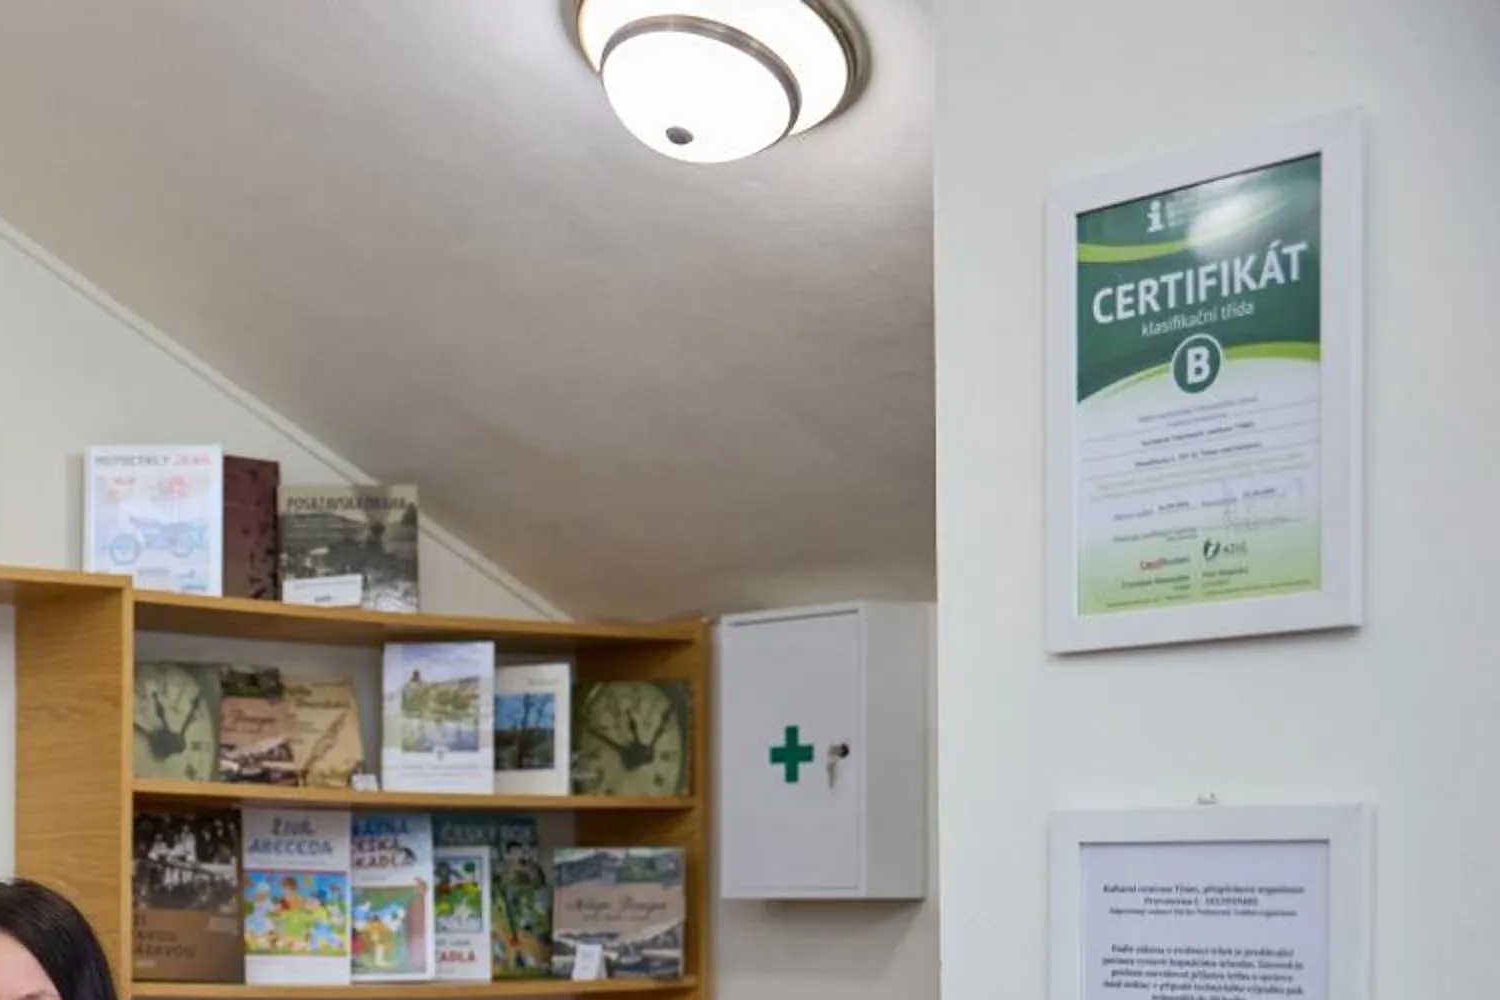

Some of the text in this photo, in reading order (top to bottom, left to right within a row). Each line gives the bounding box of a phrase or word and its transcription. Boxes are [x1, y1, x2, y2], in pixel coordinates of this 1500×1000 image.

[1092, 239, 1308, 324] CERTIFIKÁT
[1141, 302, 1255, 337] klasifikační třída
[1186, 345, 1211, 386] B
